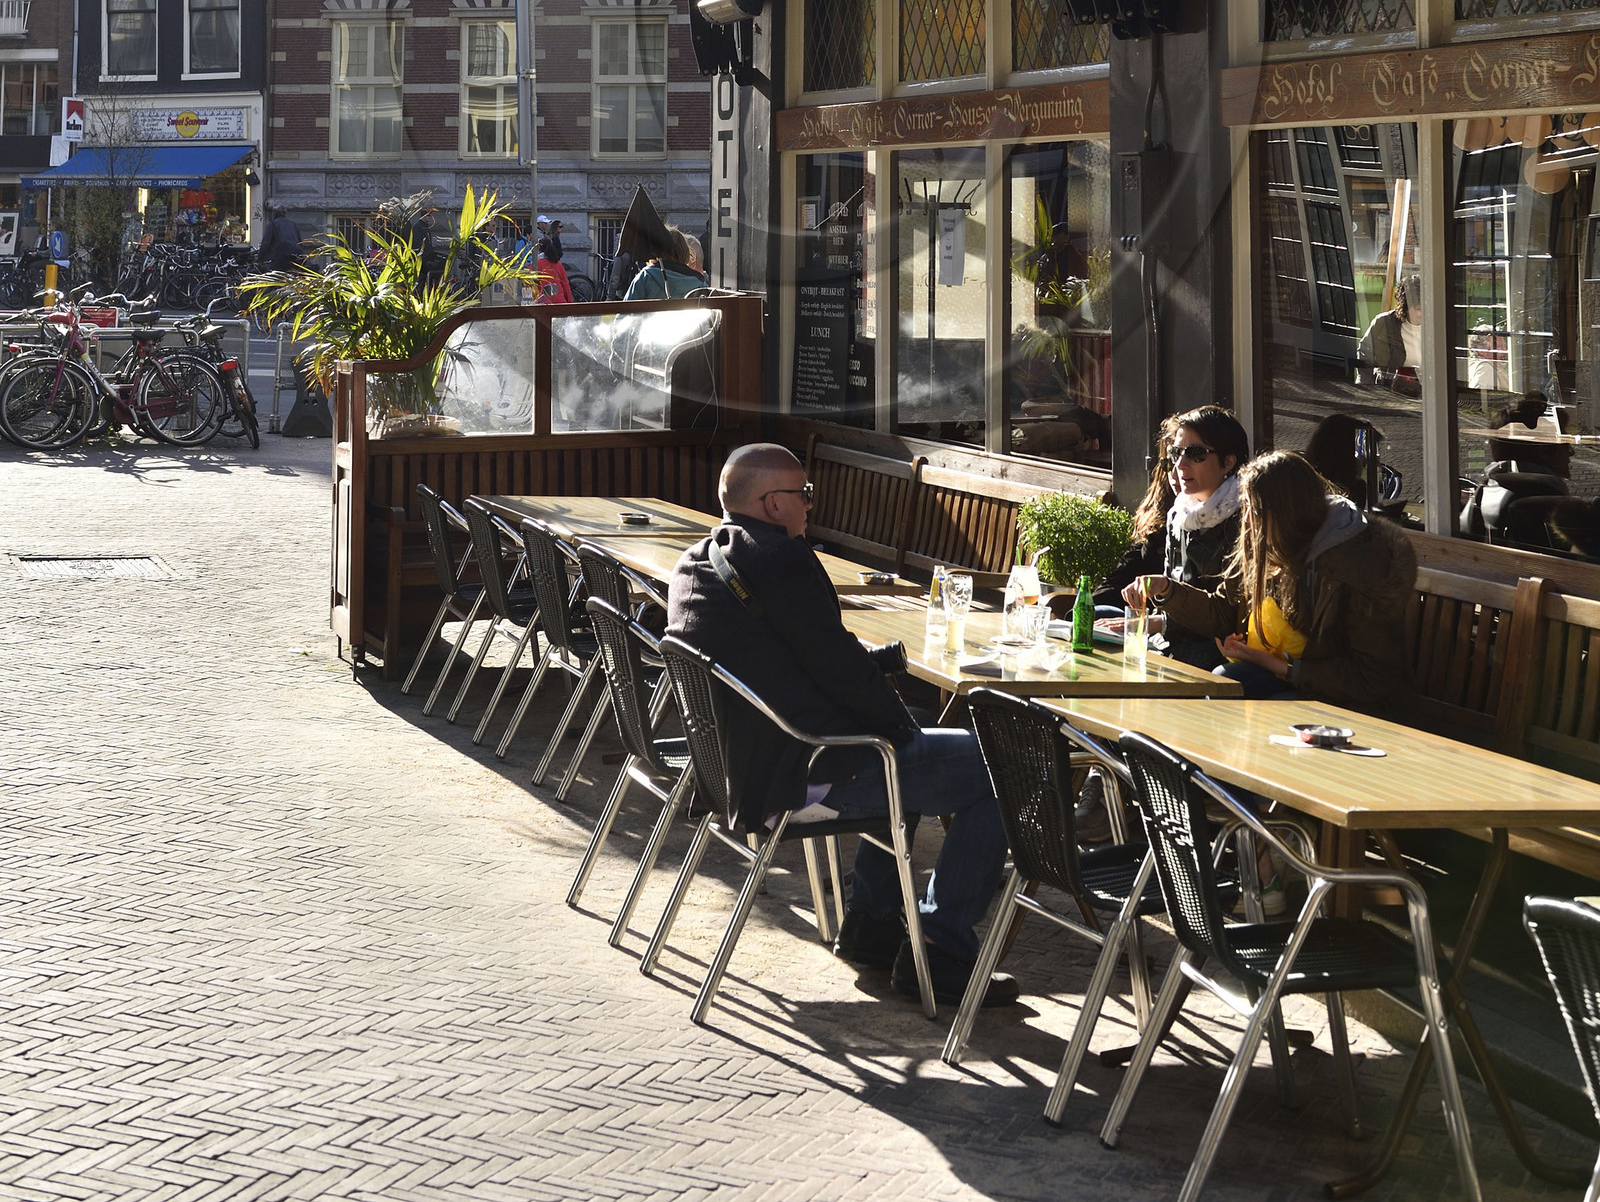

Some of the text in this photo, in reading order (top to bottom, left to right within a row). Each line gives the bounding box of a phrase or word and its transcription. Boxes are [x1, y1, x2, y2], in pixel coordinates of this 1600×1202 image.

[1262, 61, 1346, 119] Hotel
[1363, 54, 1438, 113] Café
[997, 87, 1084, 133] Vergunning
[718, 74, 734, 289] OTEL
[829, 225, 848, 233] AMSTEL
[811, 326, 830, 338] LUNCH
